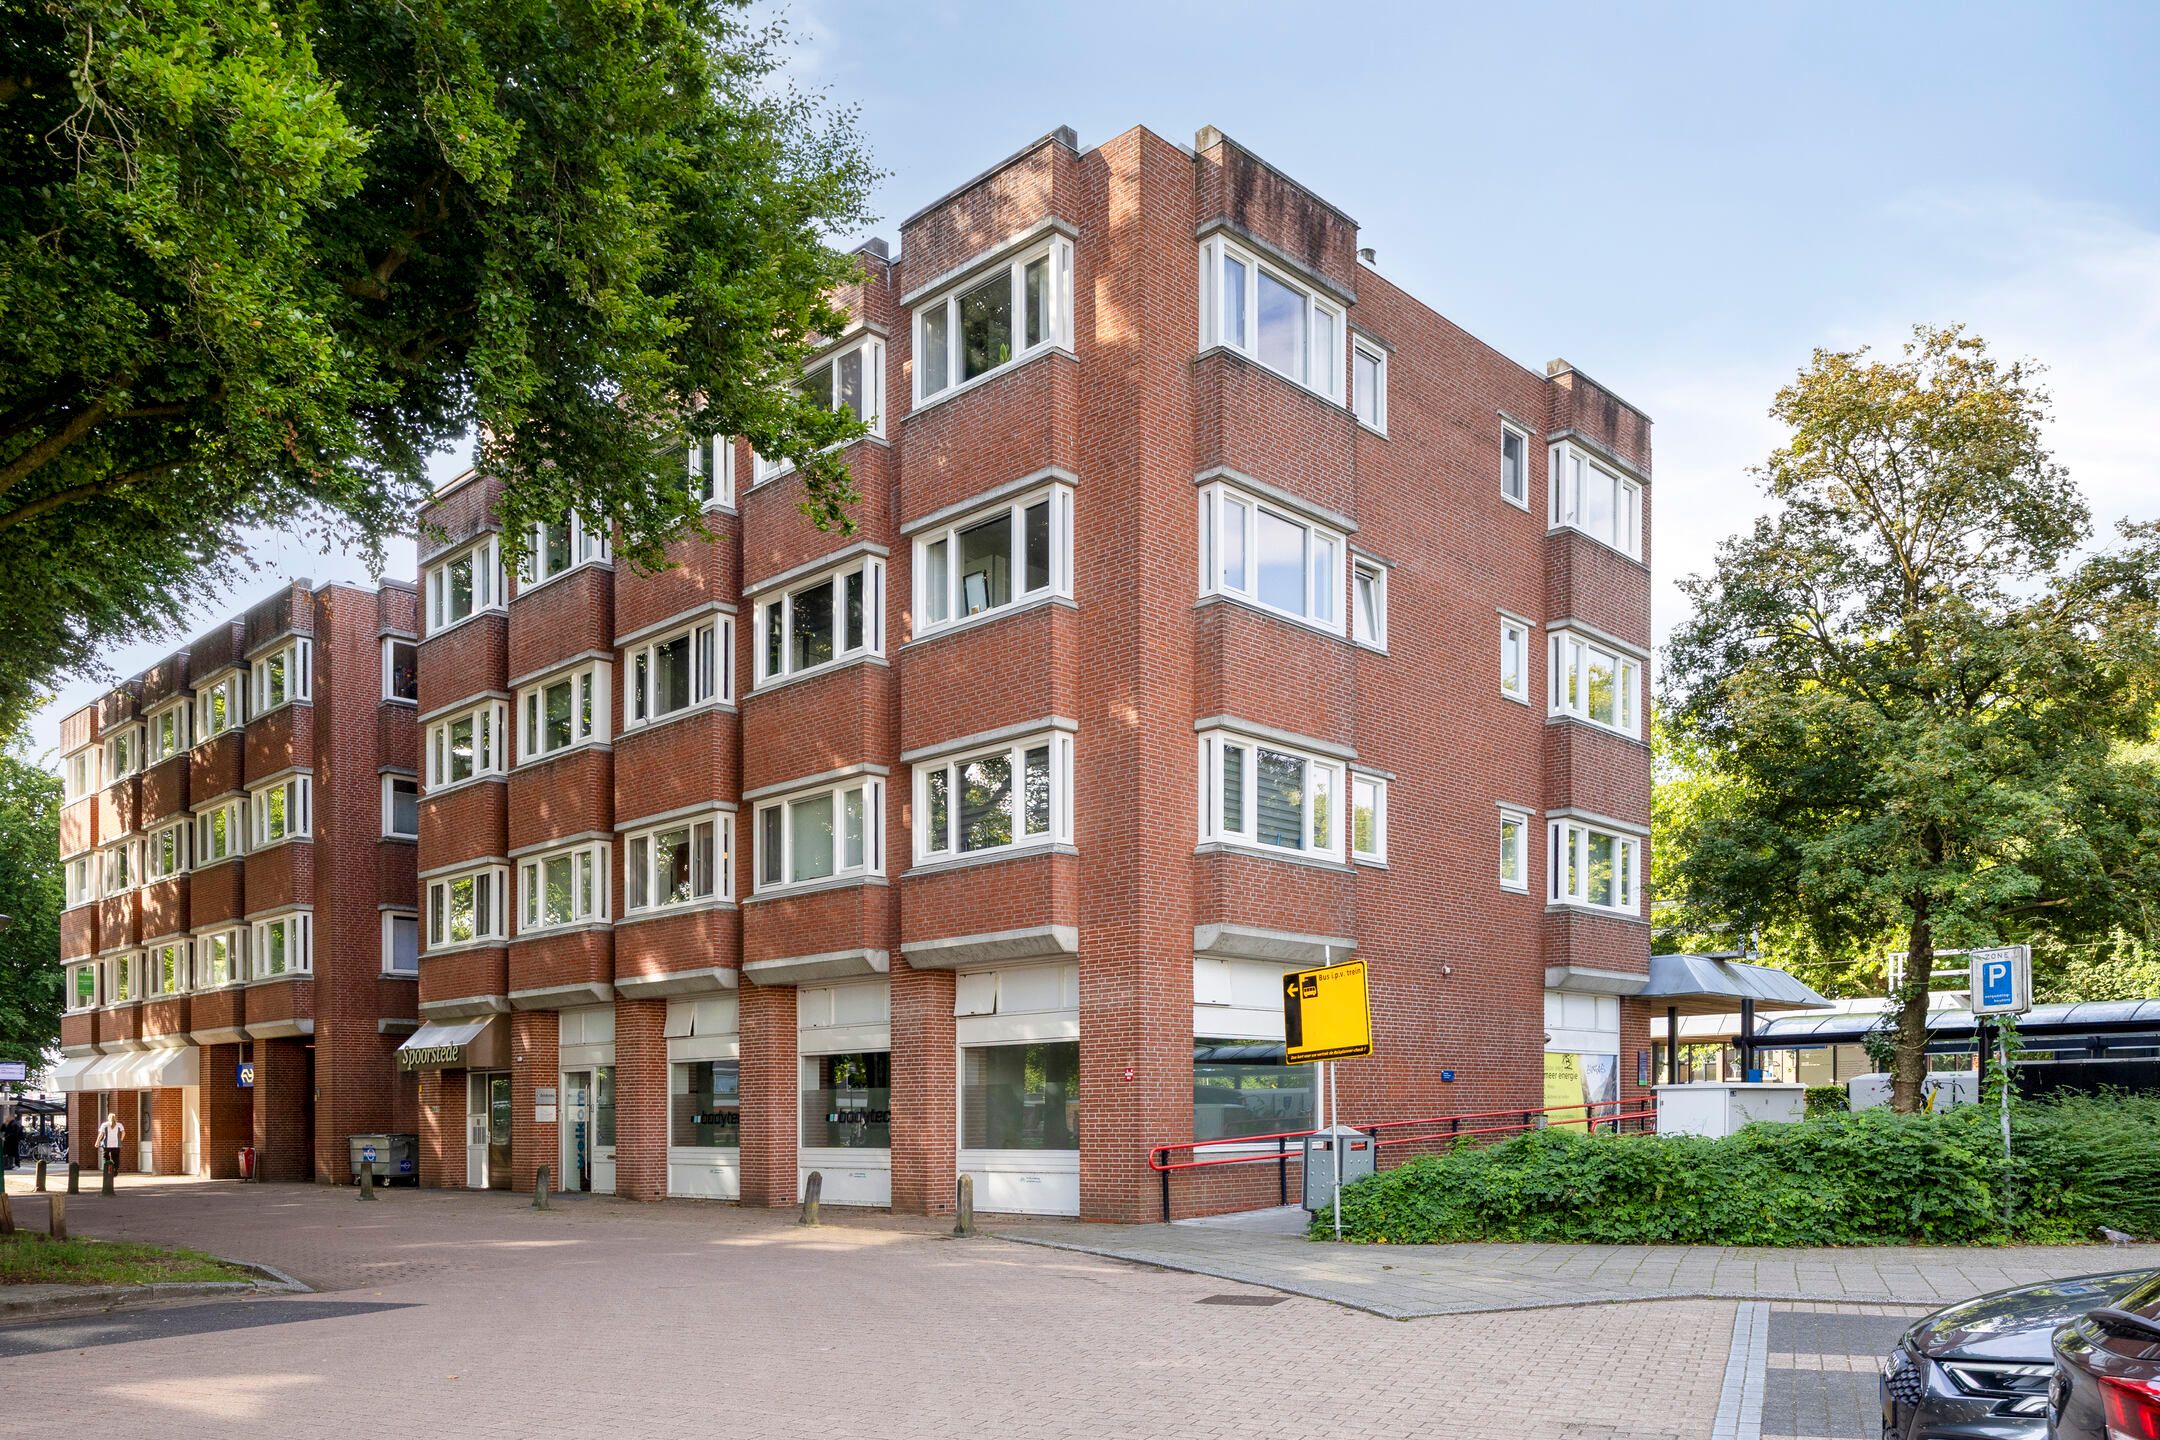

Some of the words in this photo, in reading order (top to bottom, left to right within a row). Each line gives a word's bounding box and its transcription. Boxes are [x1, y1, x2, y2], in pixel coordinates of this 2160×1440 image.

[1984, 951, 2009, 960] ZONE
[1332, 971, 1346, 980] i.p.v.
[1346, 968, 1361, 976] trein
[1989, 963, 2006, 988] P
[402, 1040, 459, 1071] Spoorstede
[1558, 1072, 1578, 1082] energie
[701, 1110, 740, 1128] bodyte
[576, 1090, 585, 1169] welkom
